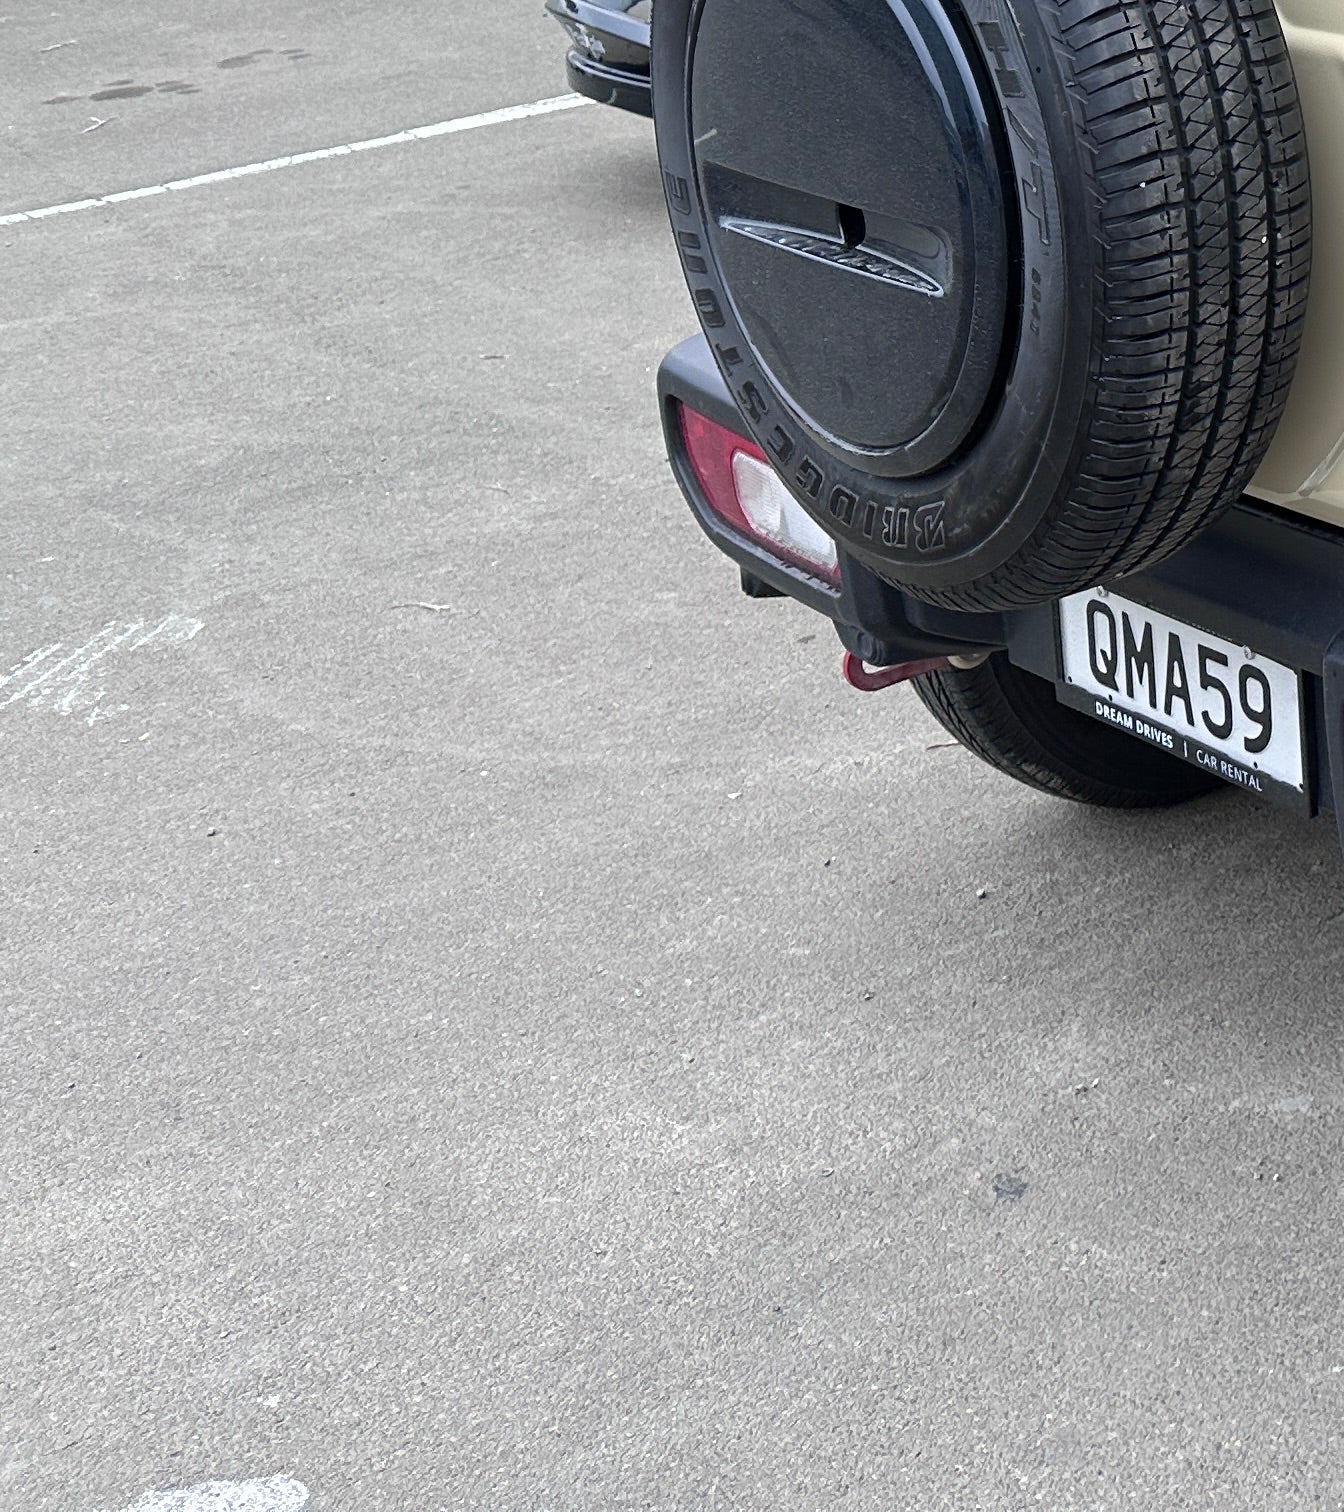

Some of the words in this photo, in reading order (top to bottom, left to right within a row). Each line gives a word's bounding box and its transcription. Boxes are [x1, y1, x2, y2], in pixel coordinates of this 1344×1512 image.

[1085, 598, 1274, 754] QMA59
[1095, 700, 1133, 730] DREAM
[1135, 721, 1174, 749] DRIVES
[1196, 749, 1219, 771] CAR
[1220, 760, 1264, 792] RENTAL
